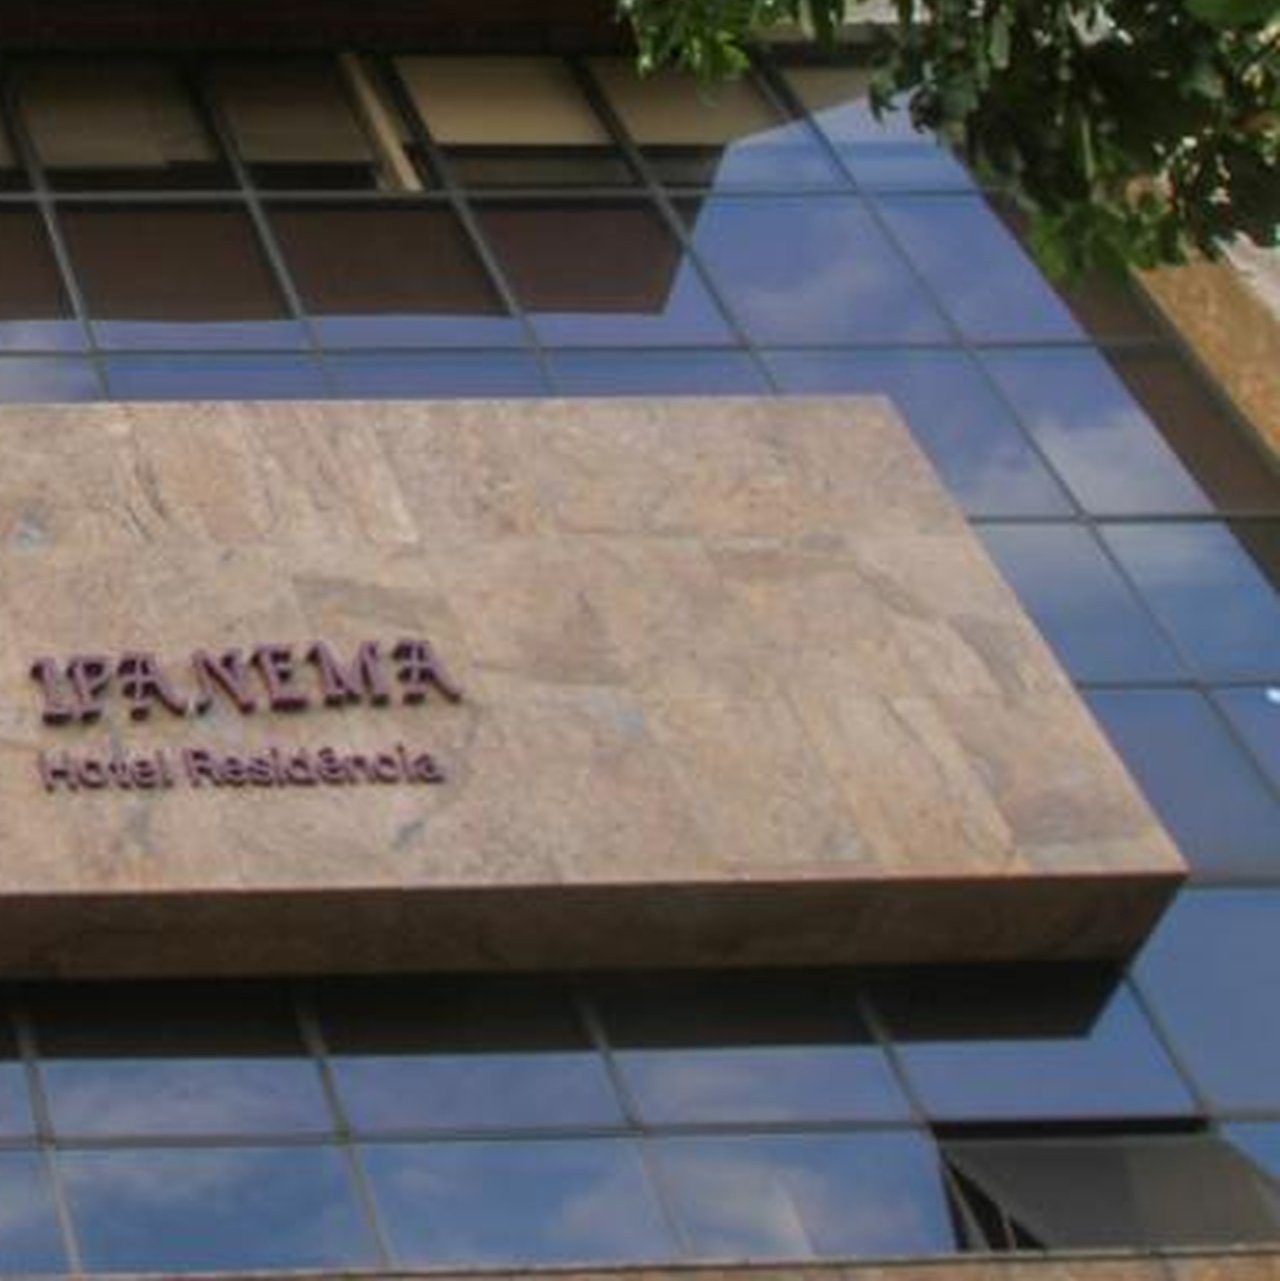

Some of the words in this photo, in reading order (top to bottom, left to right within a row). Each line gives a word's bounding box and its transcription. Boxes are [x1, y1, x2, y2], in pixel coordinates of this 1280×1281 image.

[30, 640, 462, 725] IPANEMA
[40, 749, 173, 792] Hotel
[184, 742, 445, 788] Residência
